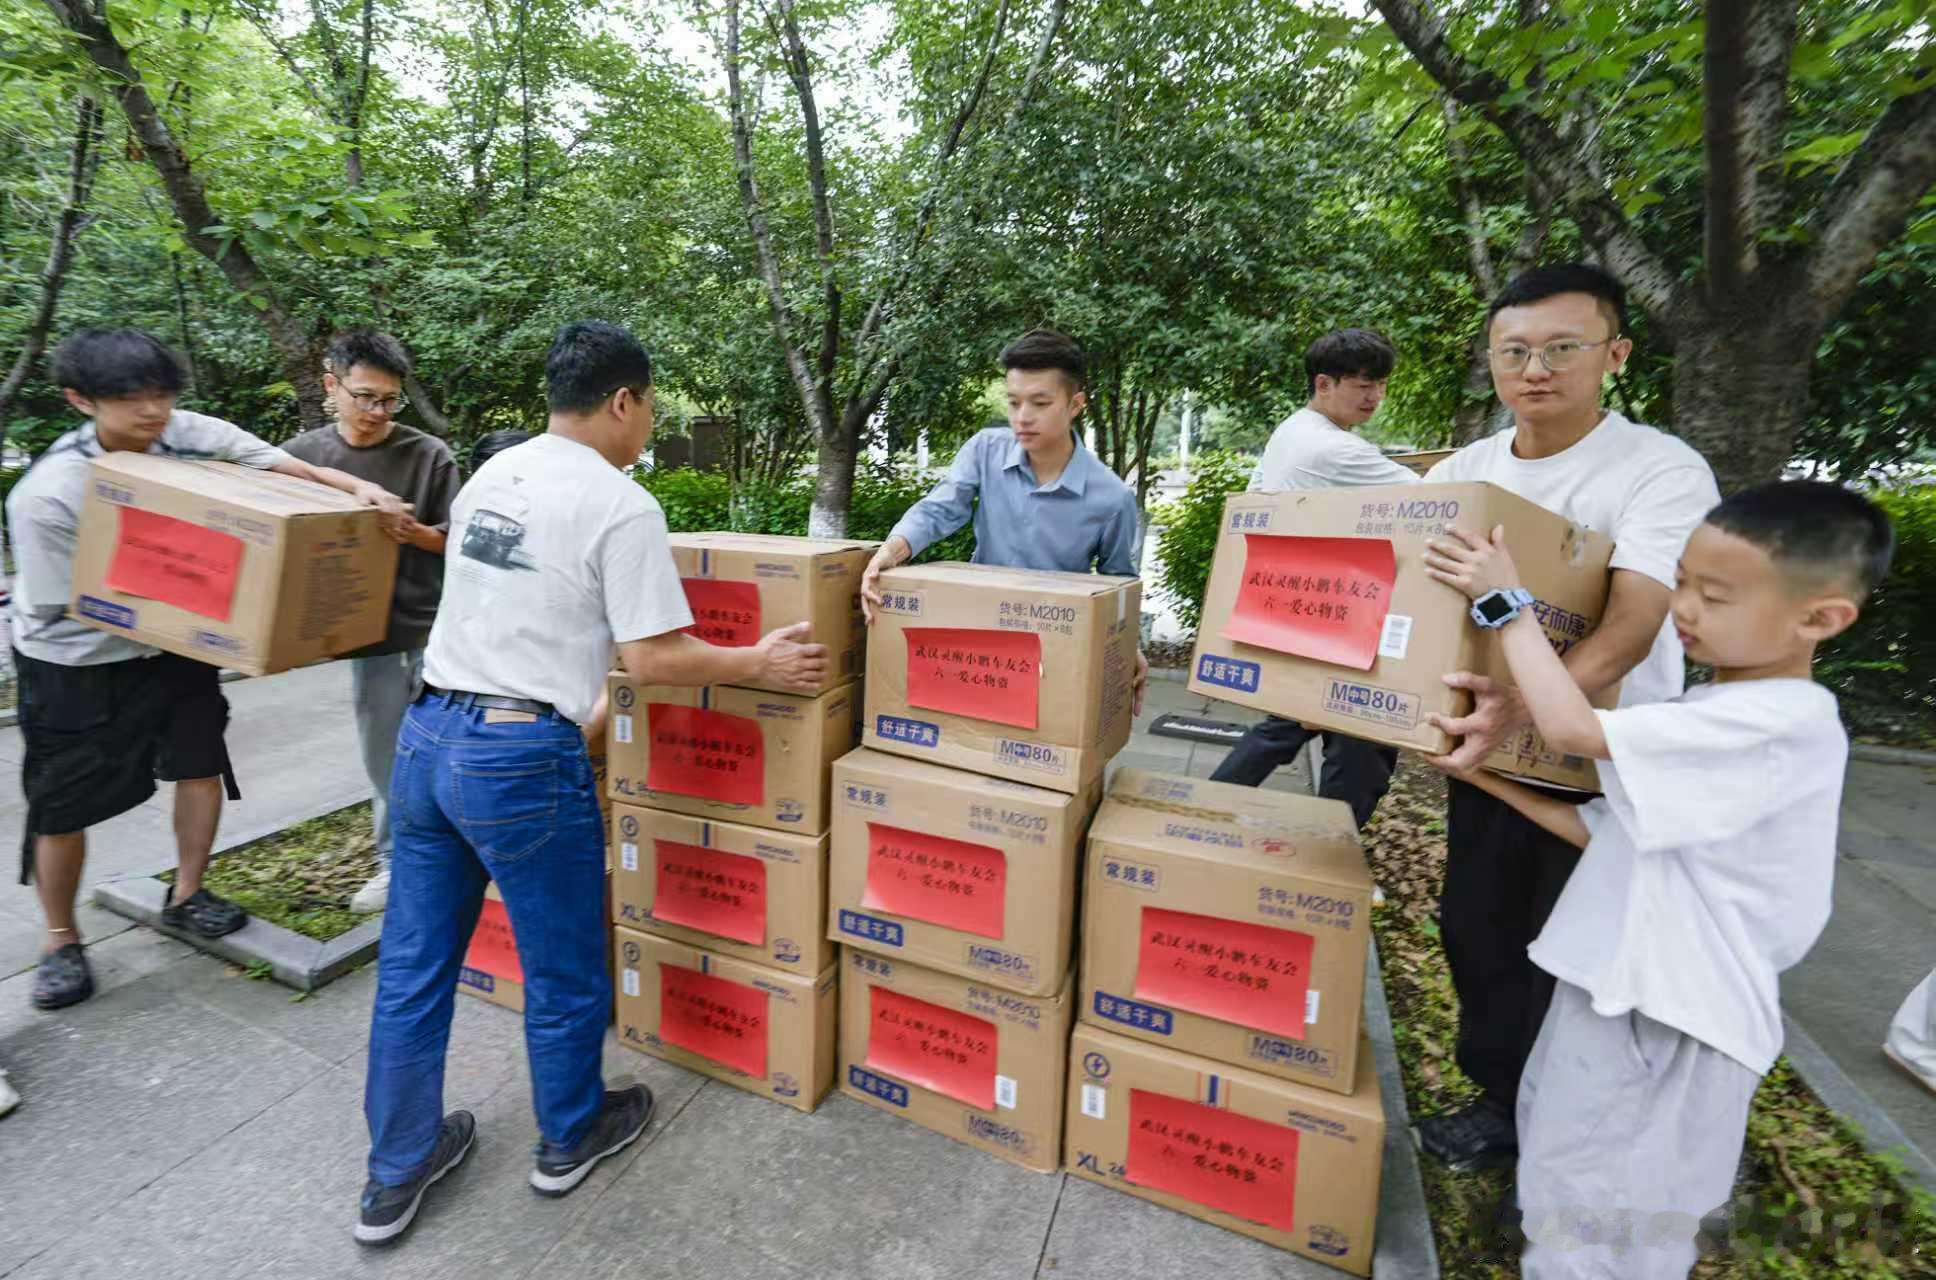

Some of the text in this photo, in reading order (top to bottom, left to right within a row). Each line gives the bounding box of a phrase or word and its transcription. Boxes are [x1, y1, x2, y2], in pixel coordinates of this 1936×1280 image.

[1231, 510, 1271, 529] 常规装
[1397, 499, 1460, 519] M2010
[881, 594, 920, 612] 常规装
[1030, 603, 1076, 622] M2010
[1264, 596, 1349, 621] 六一爱心物资
[1201, 660, 1255, 687] 舒适干爽
[881, 720, 938, 743] 舒适干爽
[1077, 1150, 1105, 1177] XL
